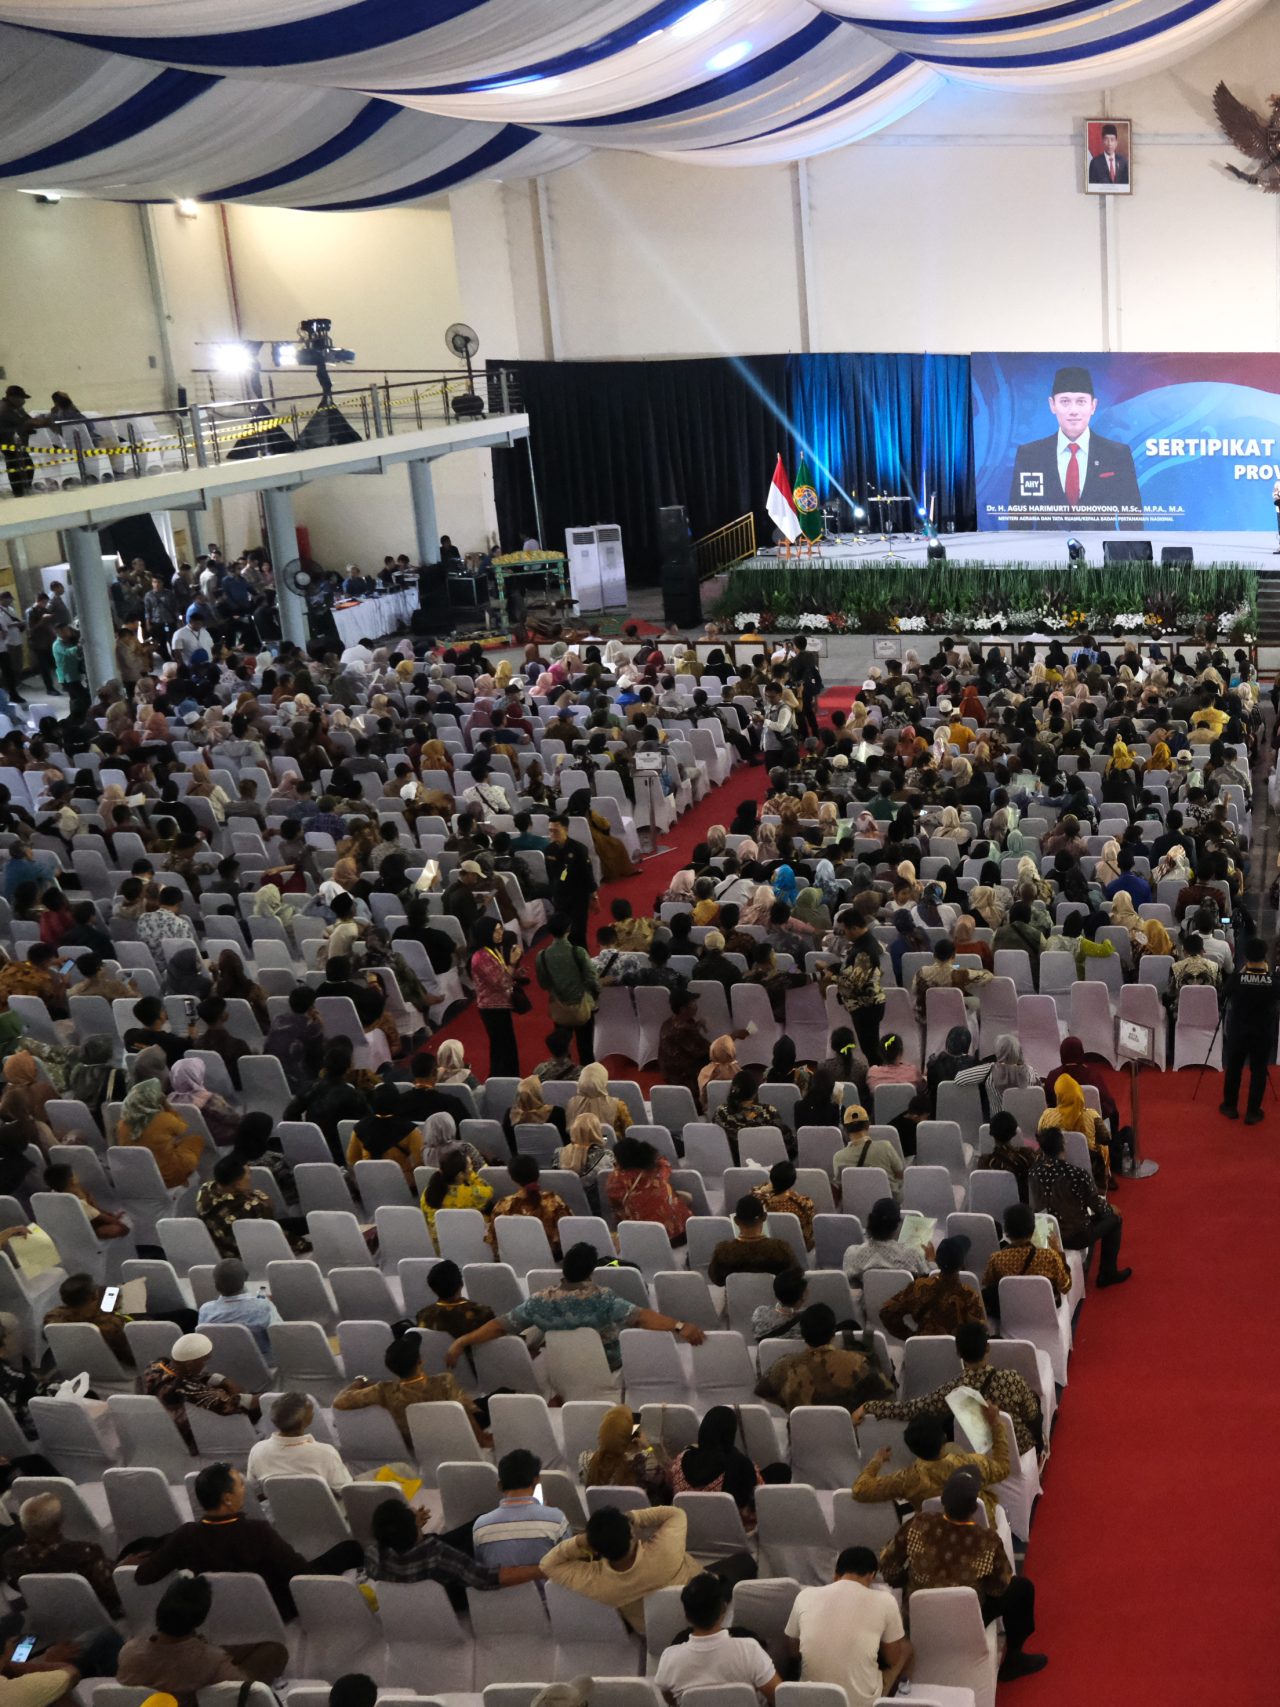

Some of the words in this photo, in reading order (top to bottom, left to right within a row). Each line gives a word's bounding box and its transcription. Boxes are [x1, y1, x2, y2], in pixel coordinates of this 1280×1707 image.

[1145, 438, 1275, 456] SERTIPIKAT
[1071, 505, 1119, 513] YUDHOYONO,
[1240, 974, 1272, 984] HUMAS
